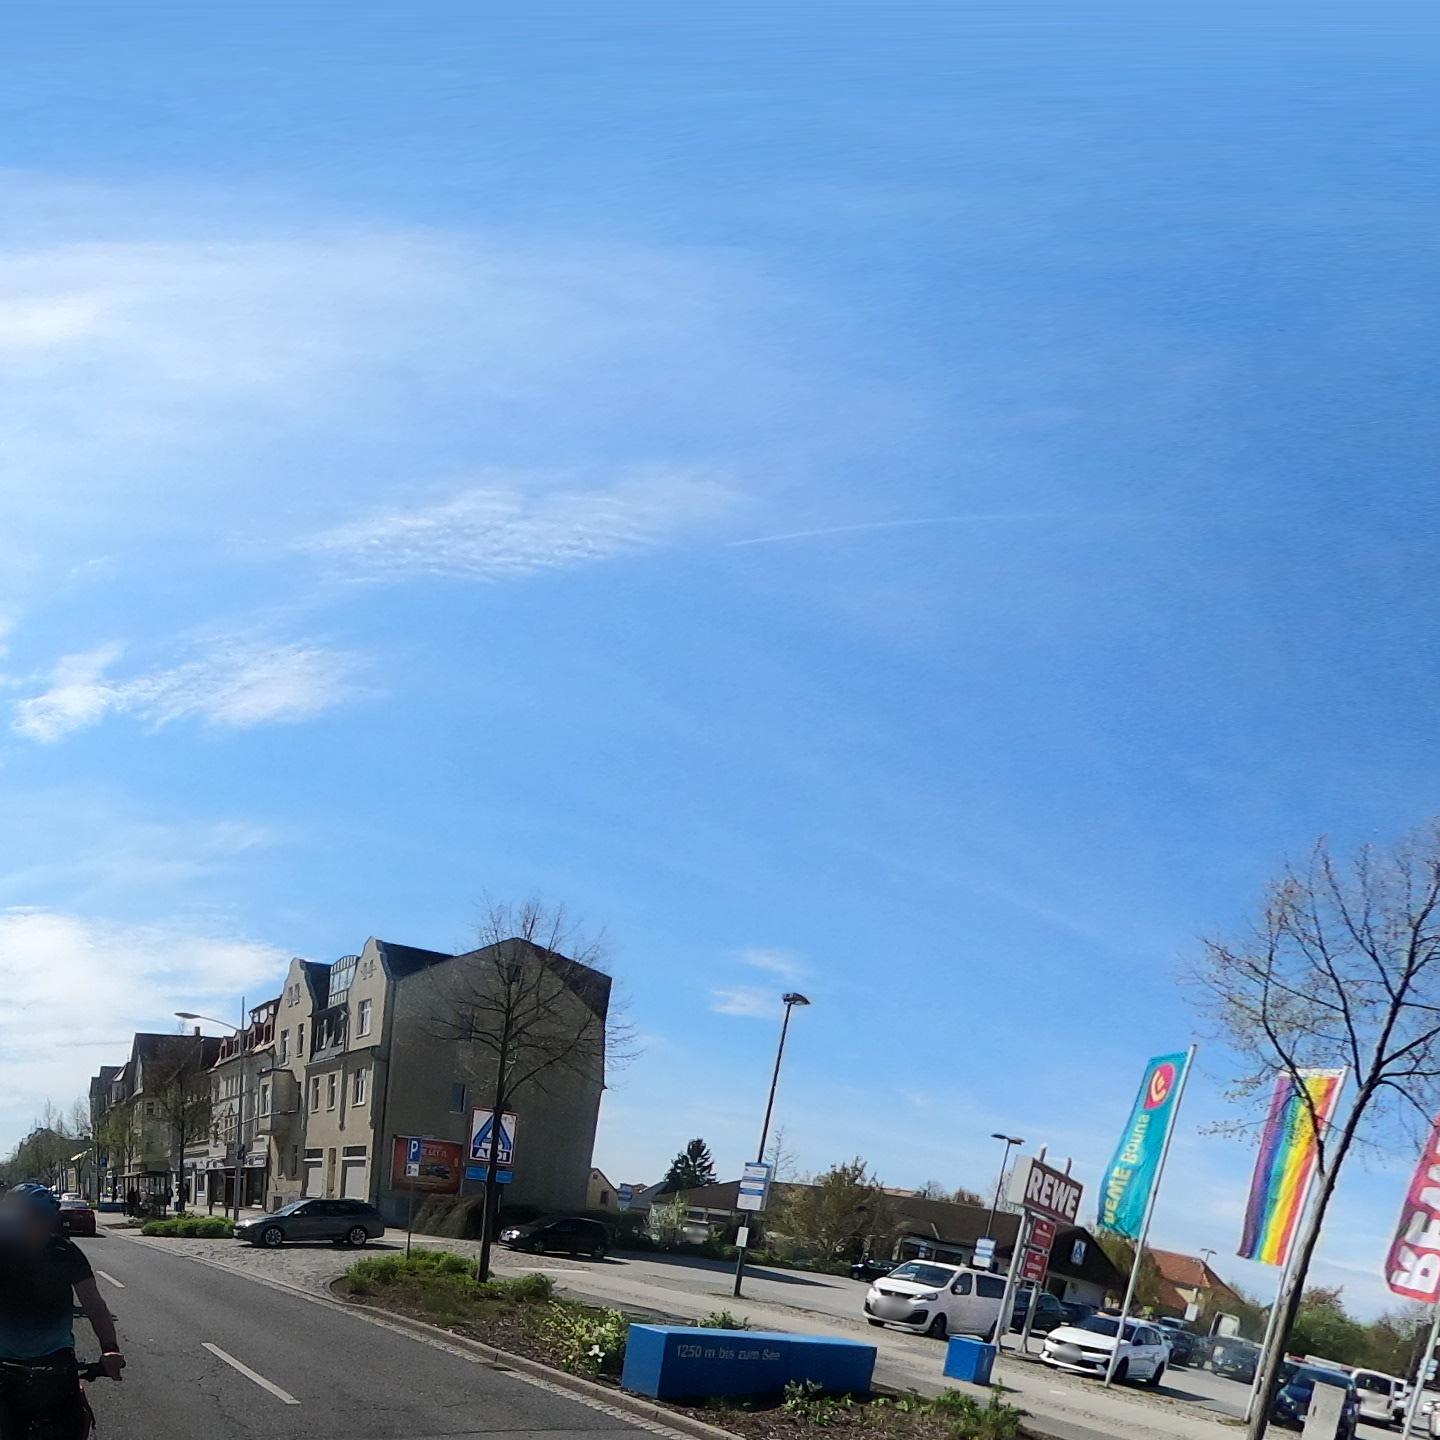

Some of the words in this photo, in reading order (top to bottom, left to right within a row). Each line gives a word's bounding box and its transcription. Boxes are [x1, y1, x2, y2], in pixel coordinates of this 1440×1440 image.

[1026, 1167, 1080, 1219] REWE
[677, 1344, 702, 1359] 1250
[704, 1349, 715, 1358] m
[719, 1347, 735, 1360] bis
